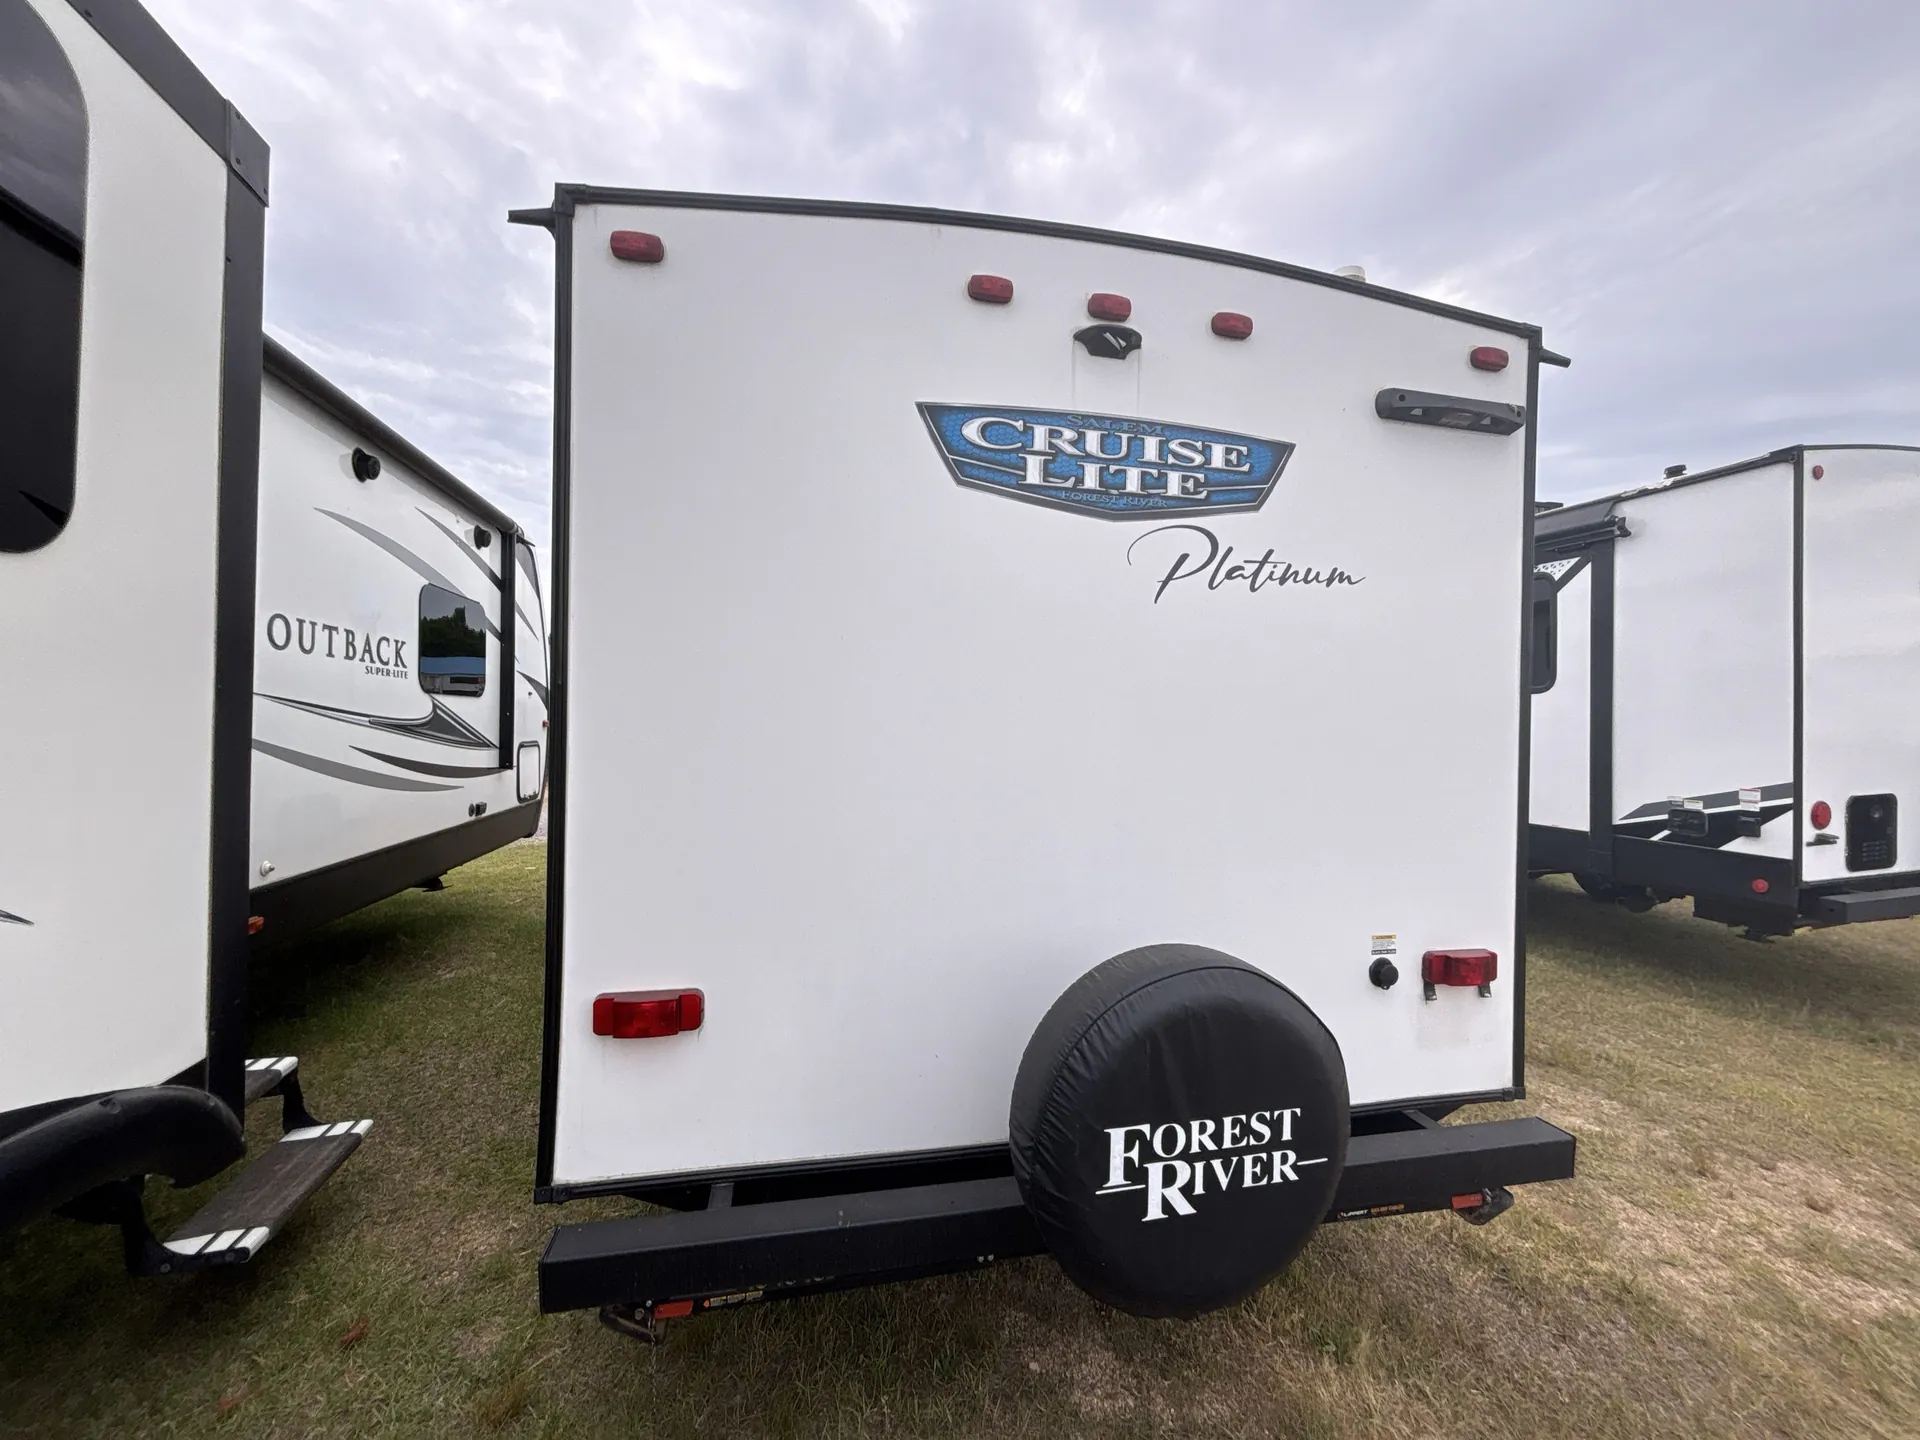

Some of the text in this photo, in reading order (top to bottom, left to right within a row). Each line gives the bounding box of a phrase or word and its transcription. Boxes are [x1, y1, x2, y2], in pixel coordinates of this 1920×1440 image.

[961, 417, 1251, 473] CRUISE
[1066, 415, 1164, 435] SALEM
[1018, 453, 1208, 499] LITE
[1061, 490, 1168, 508] FOREST RIVER
[1126, 524, 1366, 604] Platinum
[266, 613, 408, 669] OUTBACK
[1102, 1107, 1301, 1188] FOREST
[1141, 1149, 1300, 1222] RIVER
